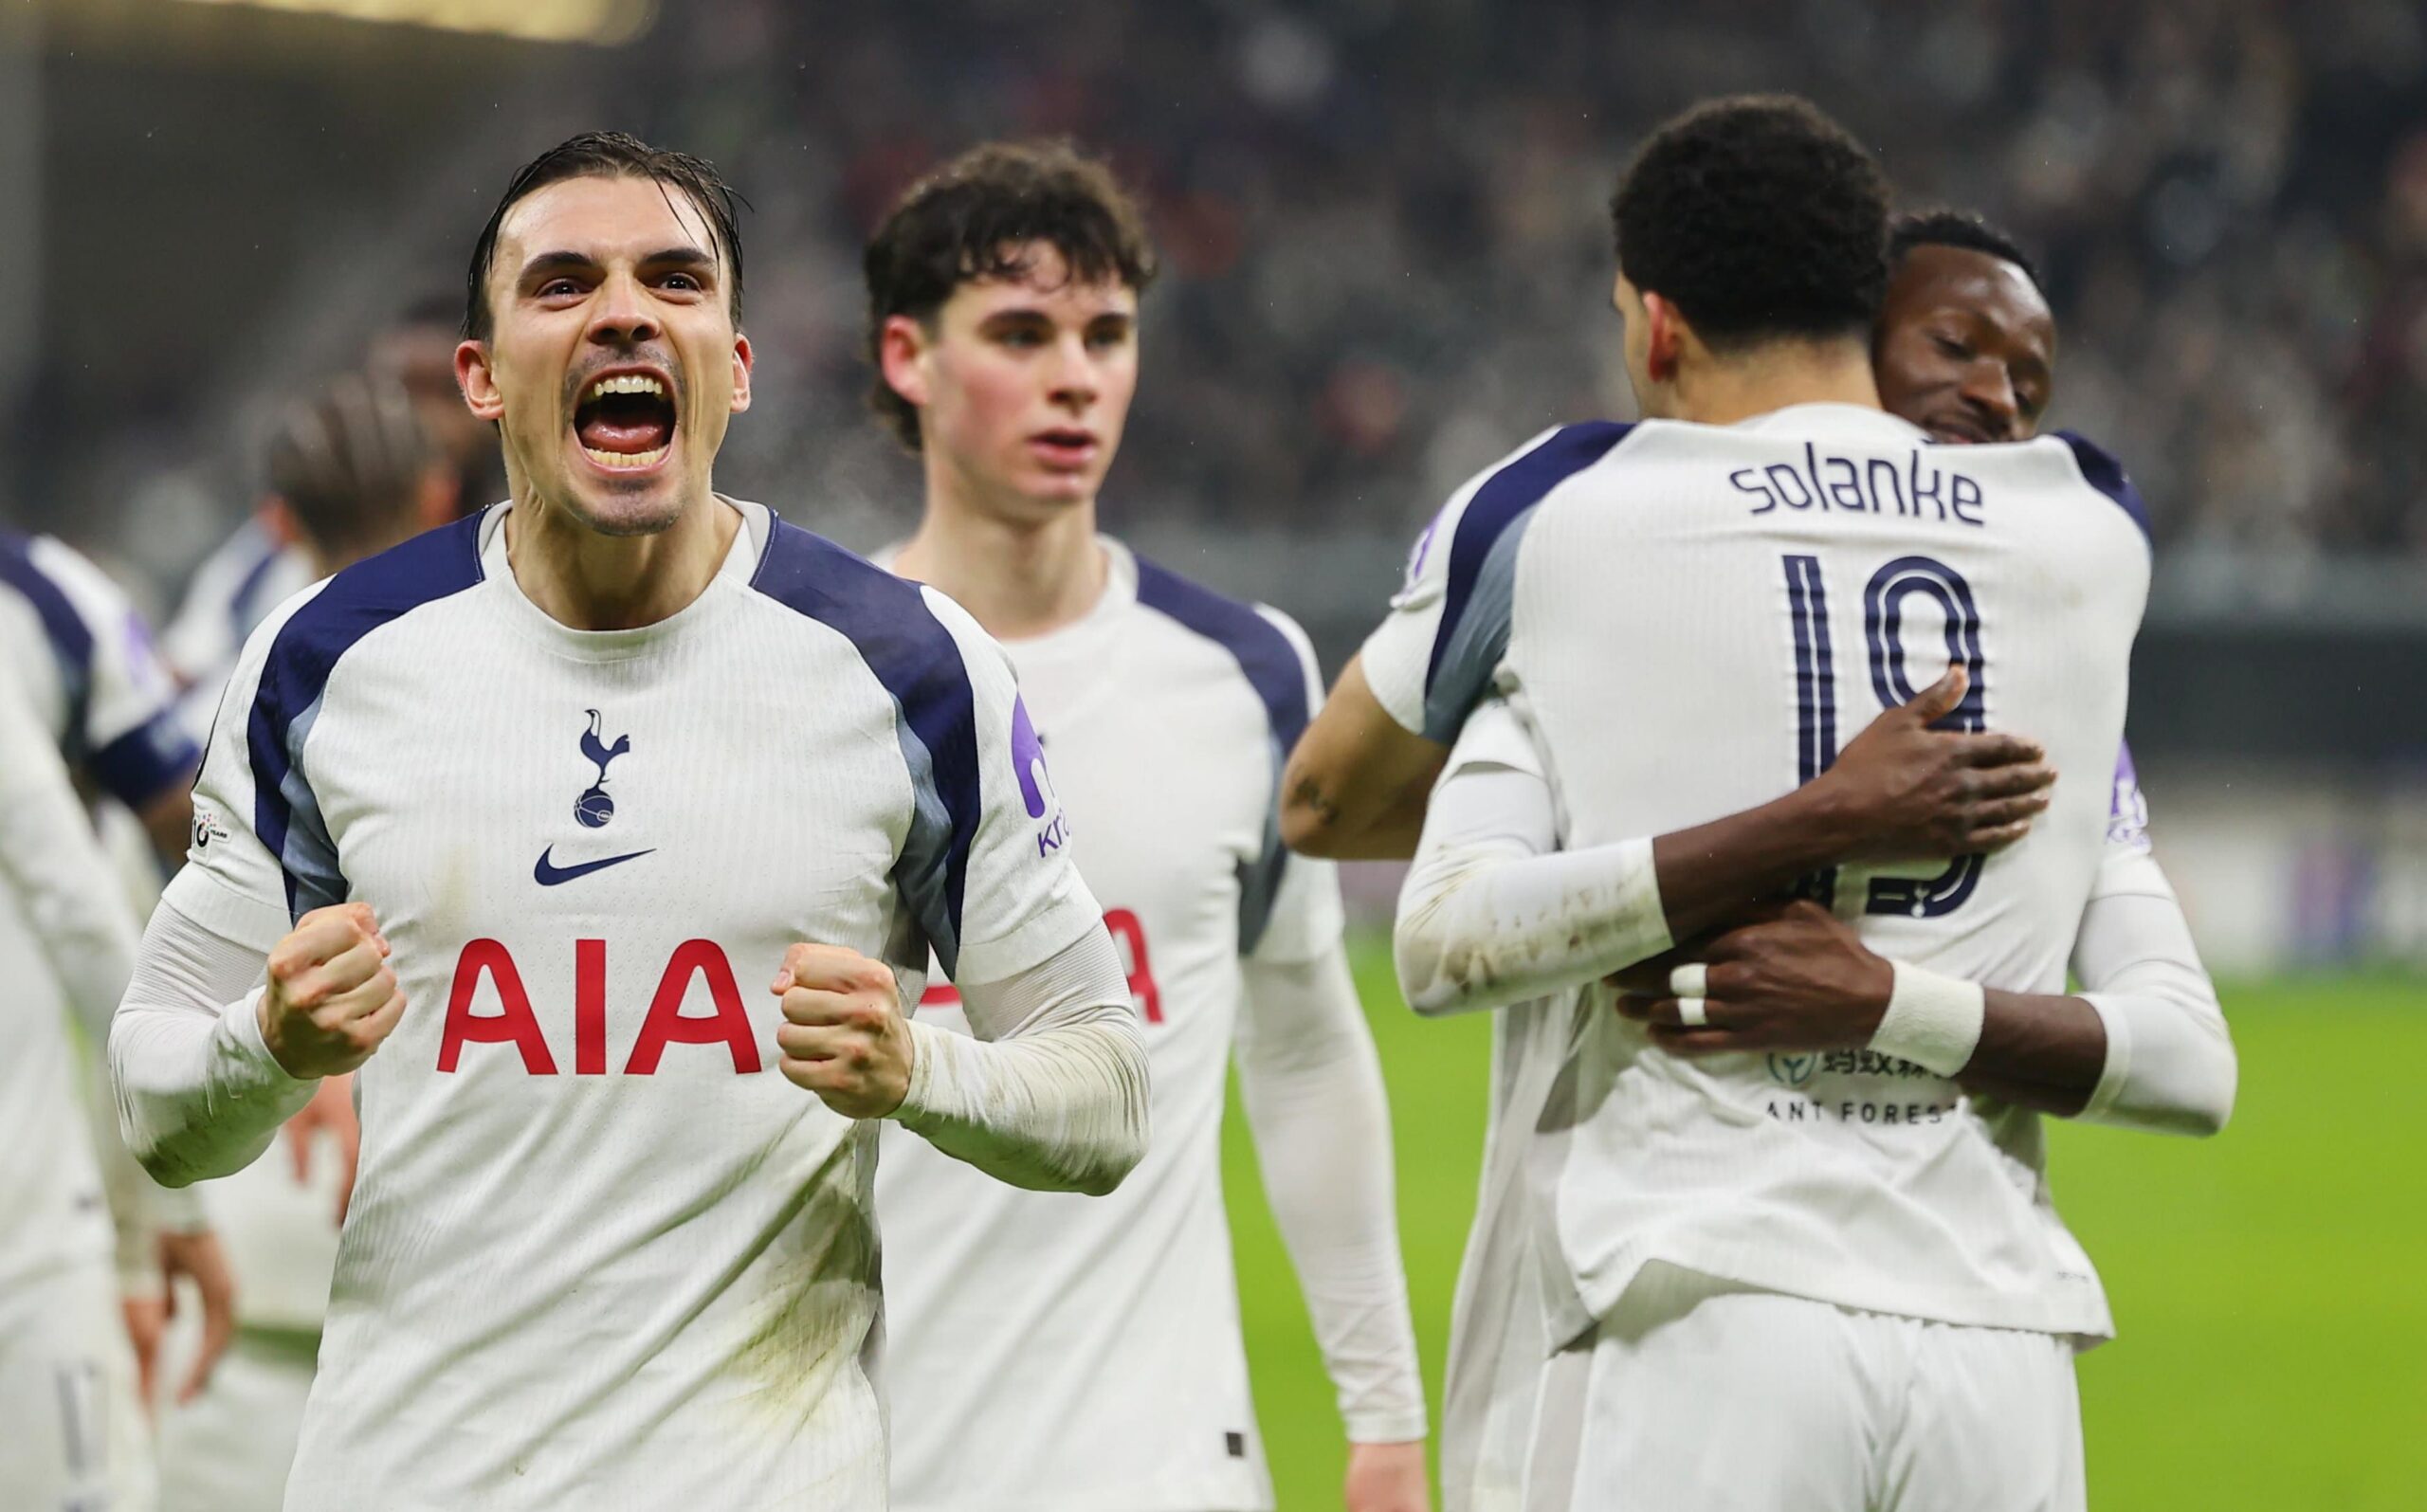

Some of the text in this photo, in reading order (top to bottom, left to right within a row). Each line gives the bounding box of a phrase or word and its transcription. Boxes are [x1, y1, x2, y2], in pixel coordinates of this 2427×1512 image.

[1730, 442, 1985, 526] solanke
[1781, 555, 1988, 918] 19
[437, 938, 761, 1075] AIA
[1767, 1101, 1822, 1122] ANT
